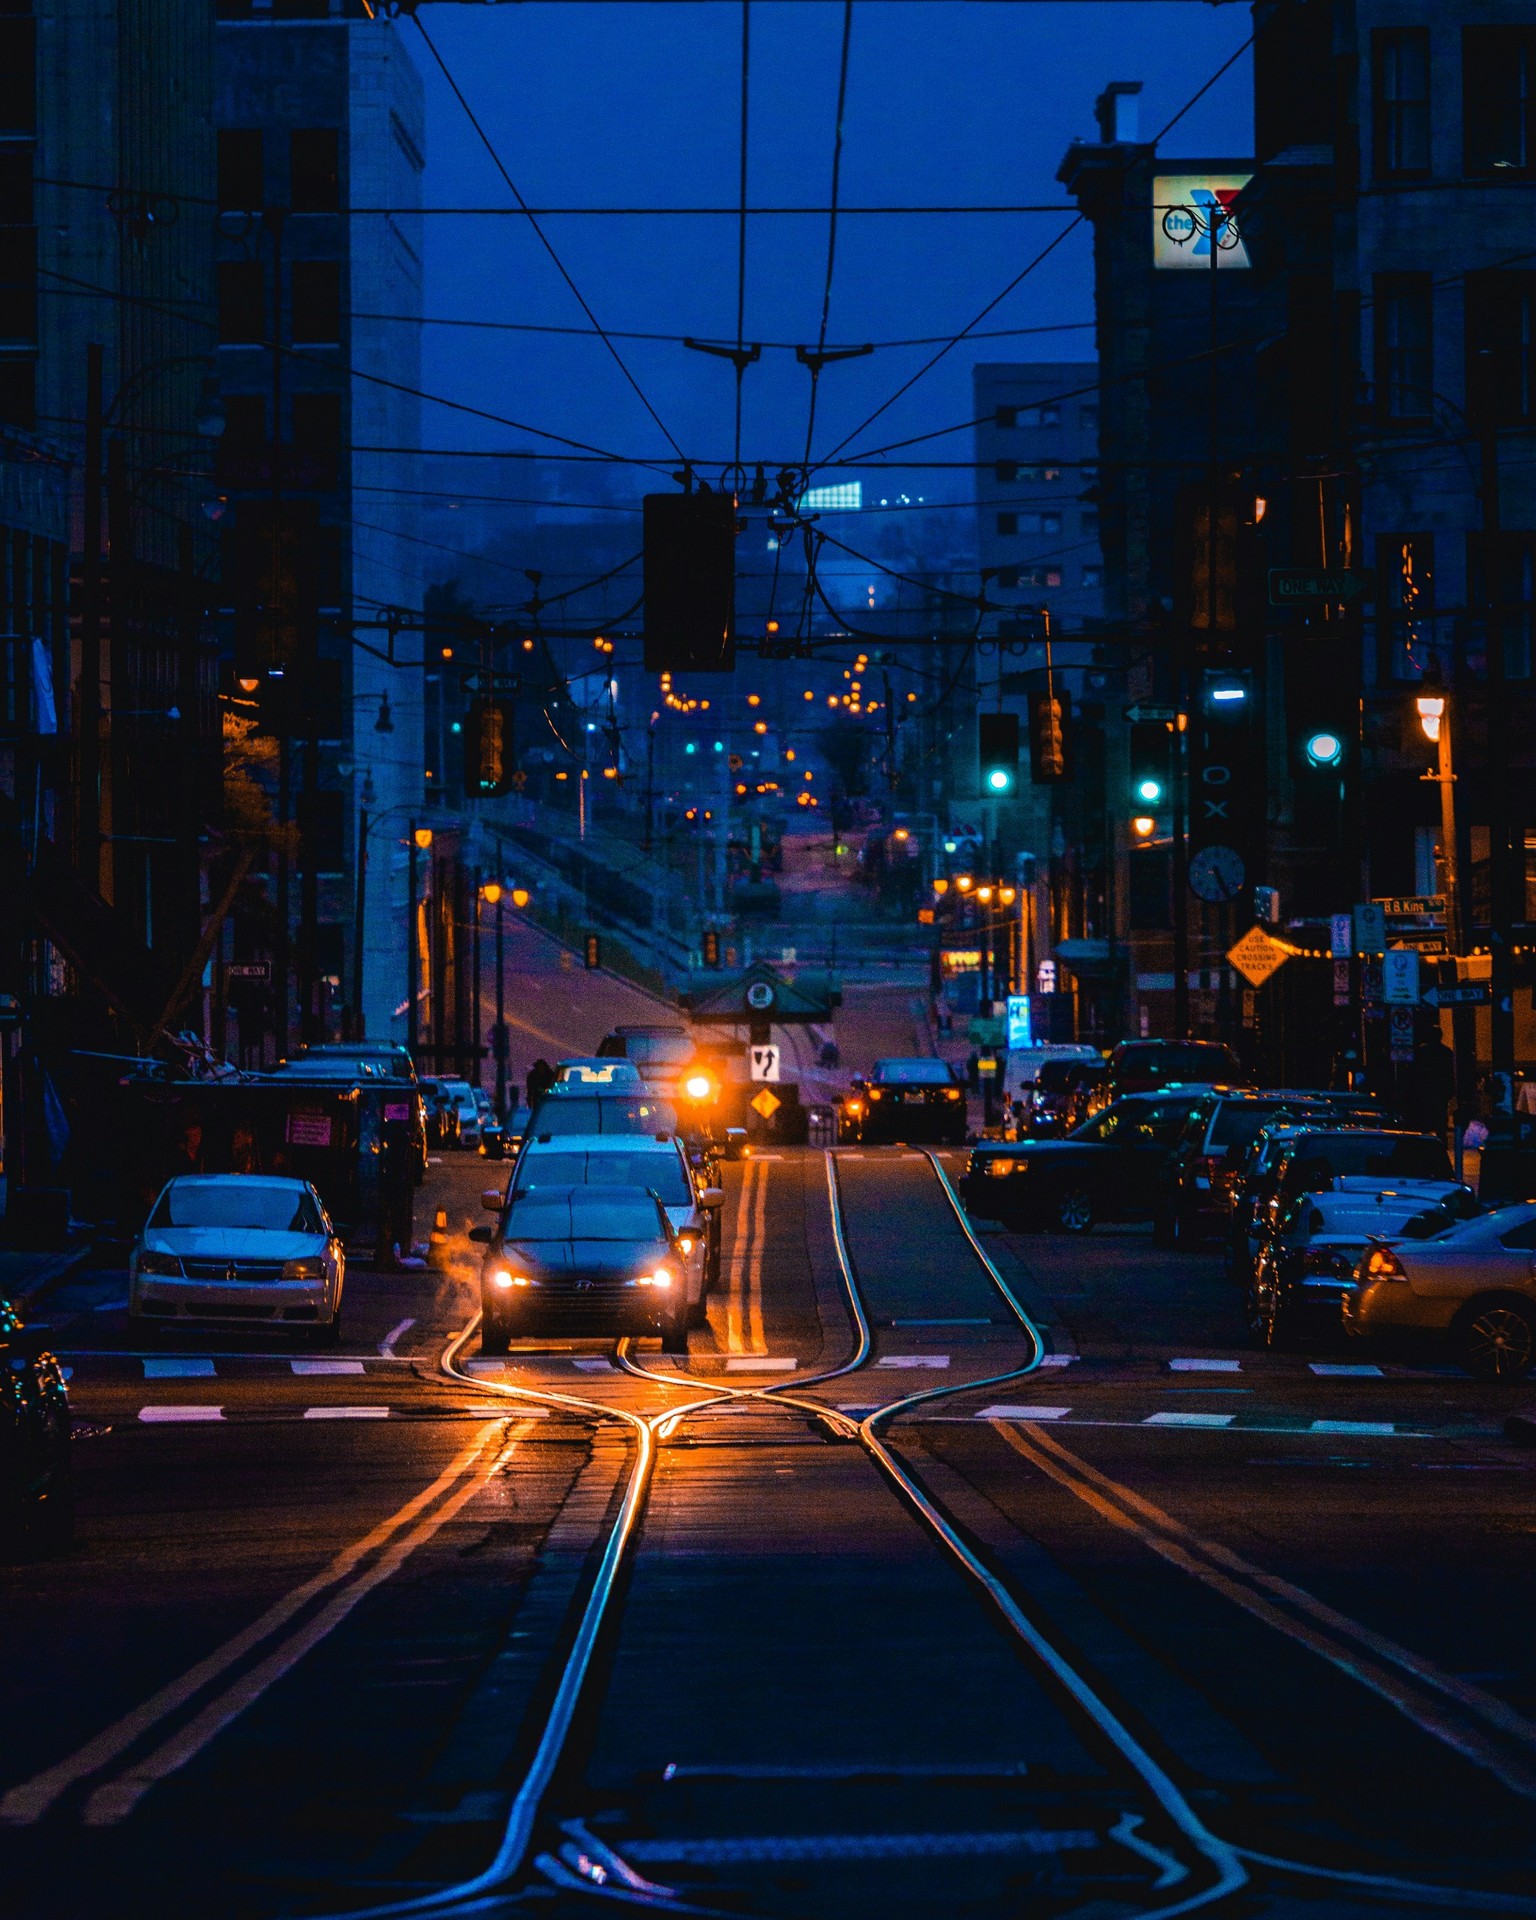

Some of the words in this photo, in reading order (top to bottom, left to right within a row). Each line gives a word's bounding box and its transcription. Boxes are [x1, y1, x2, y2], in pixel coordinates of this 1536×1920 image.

[1166, 215, 1192, 230] the
[1283, 578, 1310, 593] ONE
[1316, 578, 1345, 593] WAY
[1437, 989, 1456, 1002] ONE
